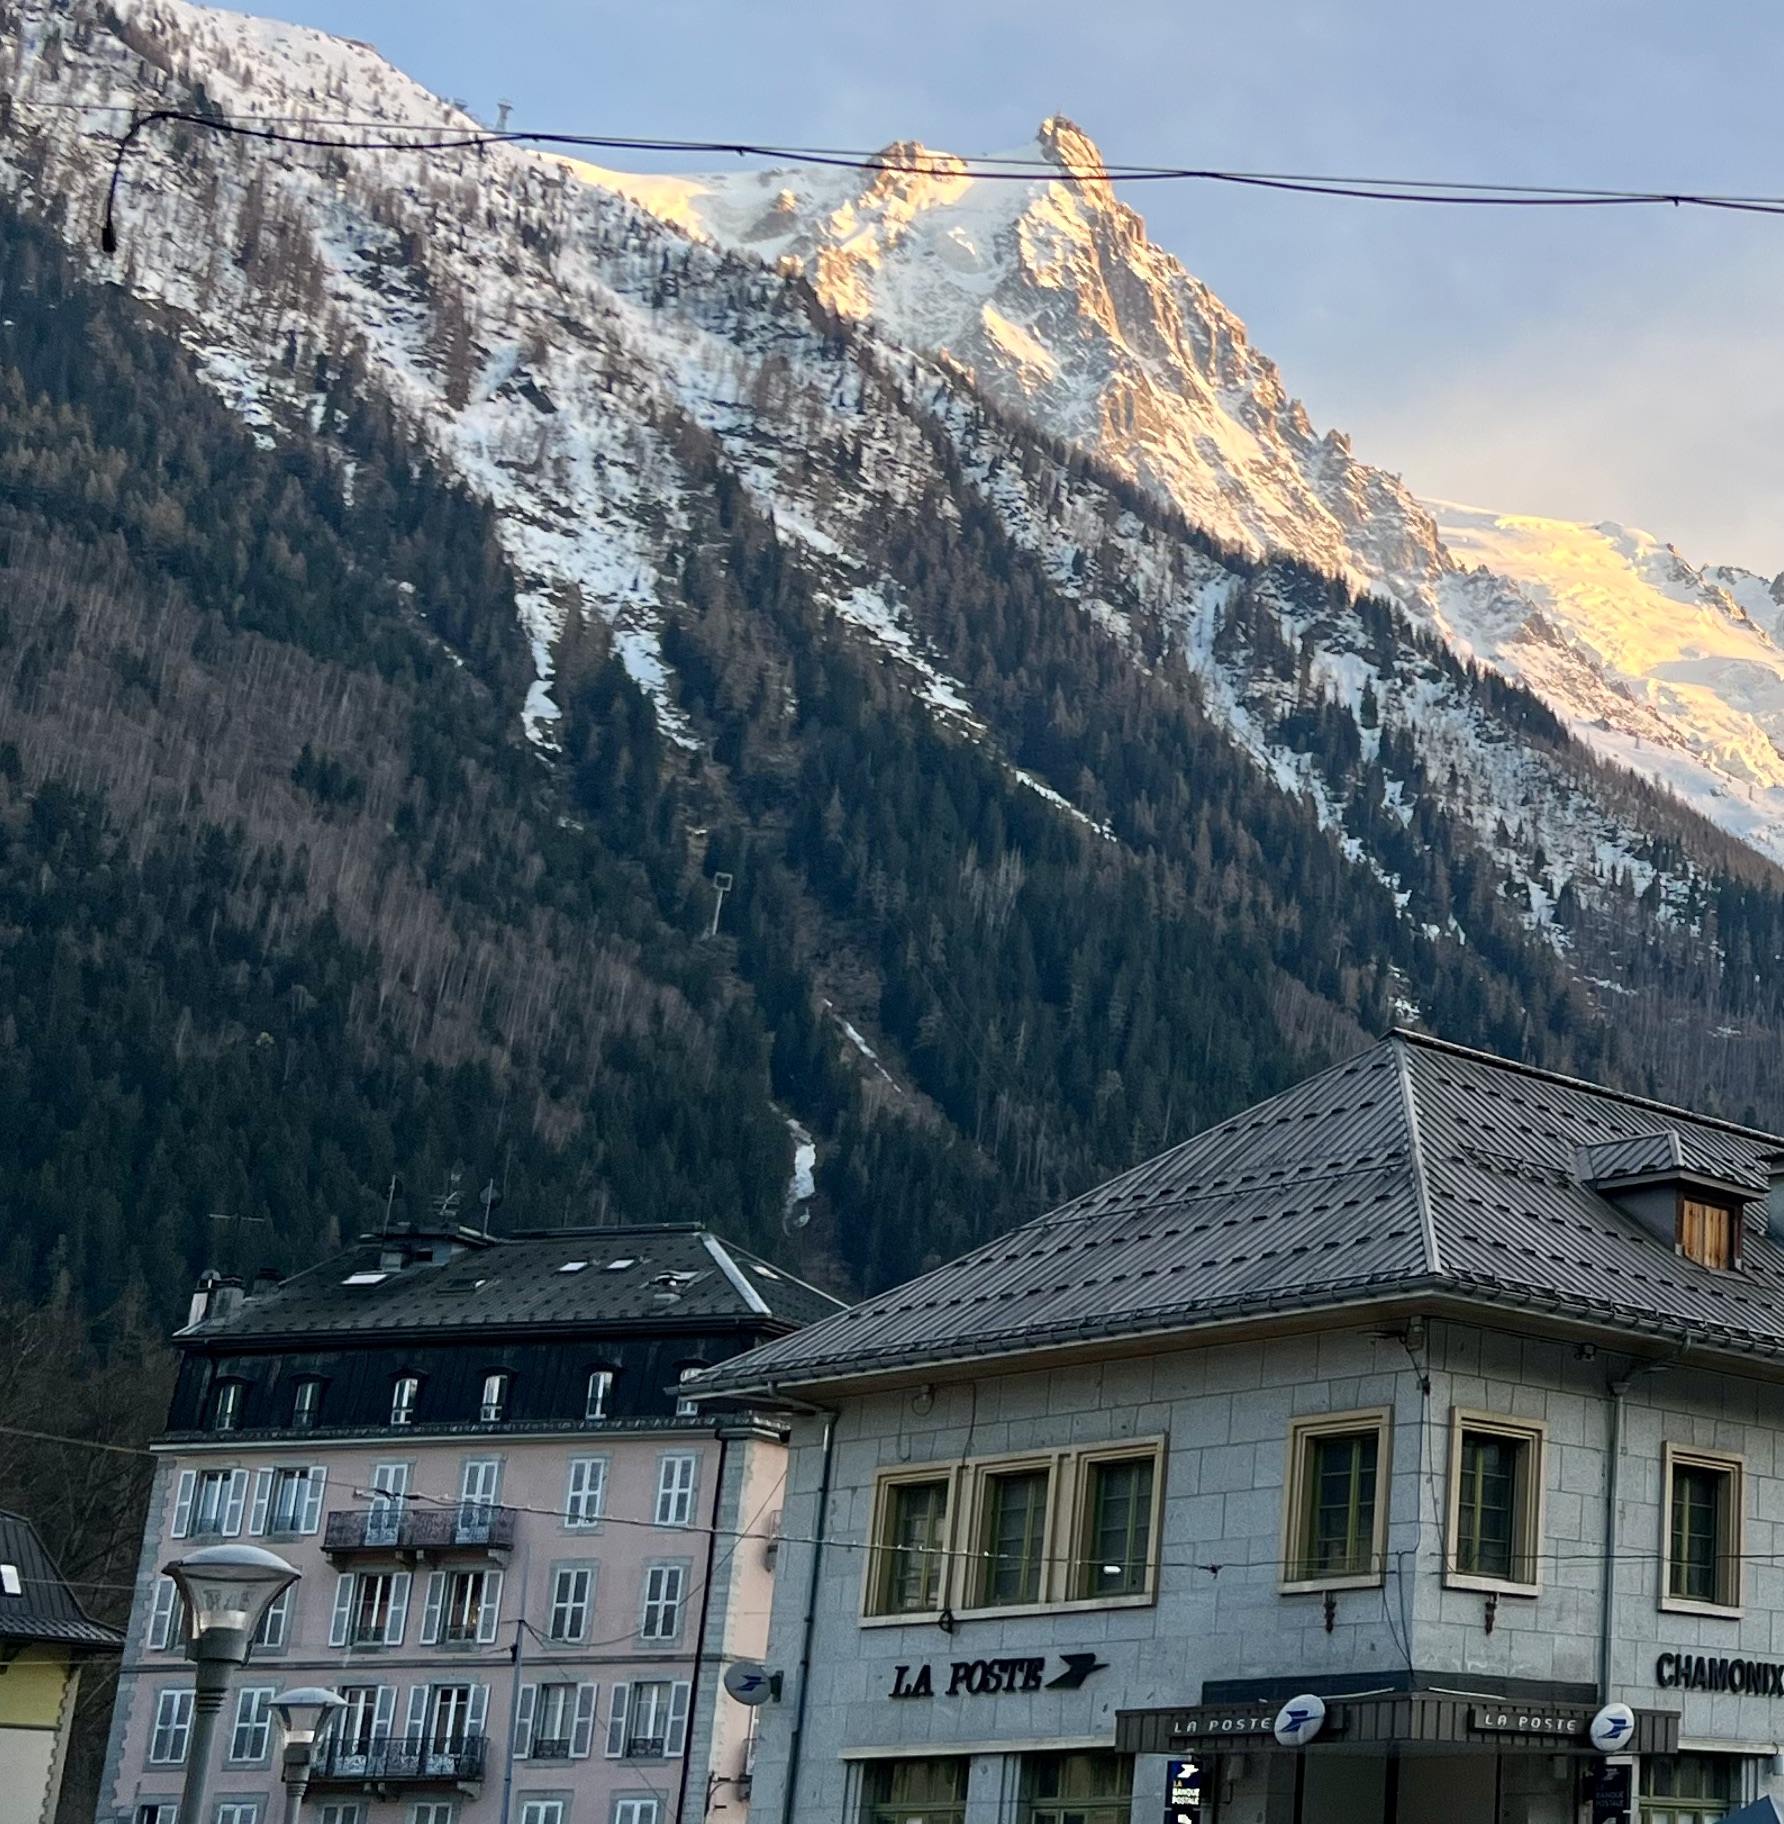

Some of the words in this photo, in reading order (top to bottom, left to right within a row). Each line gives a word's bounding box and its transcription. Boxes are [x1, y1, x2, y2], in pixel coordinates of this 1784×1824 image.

[888, 1664, 934, 1697] LA
[945, 1657, 1045, 1696] POSTE
[1174, 1720, 1197, 1733] LA
[1208, 1717, 1273, 1732] POSTE
[1485, 1713, 1507, 1726] LA
[1518, 1715, 1578, 1732] POSTE
